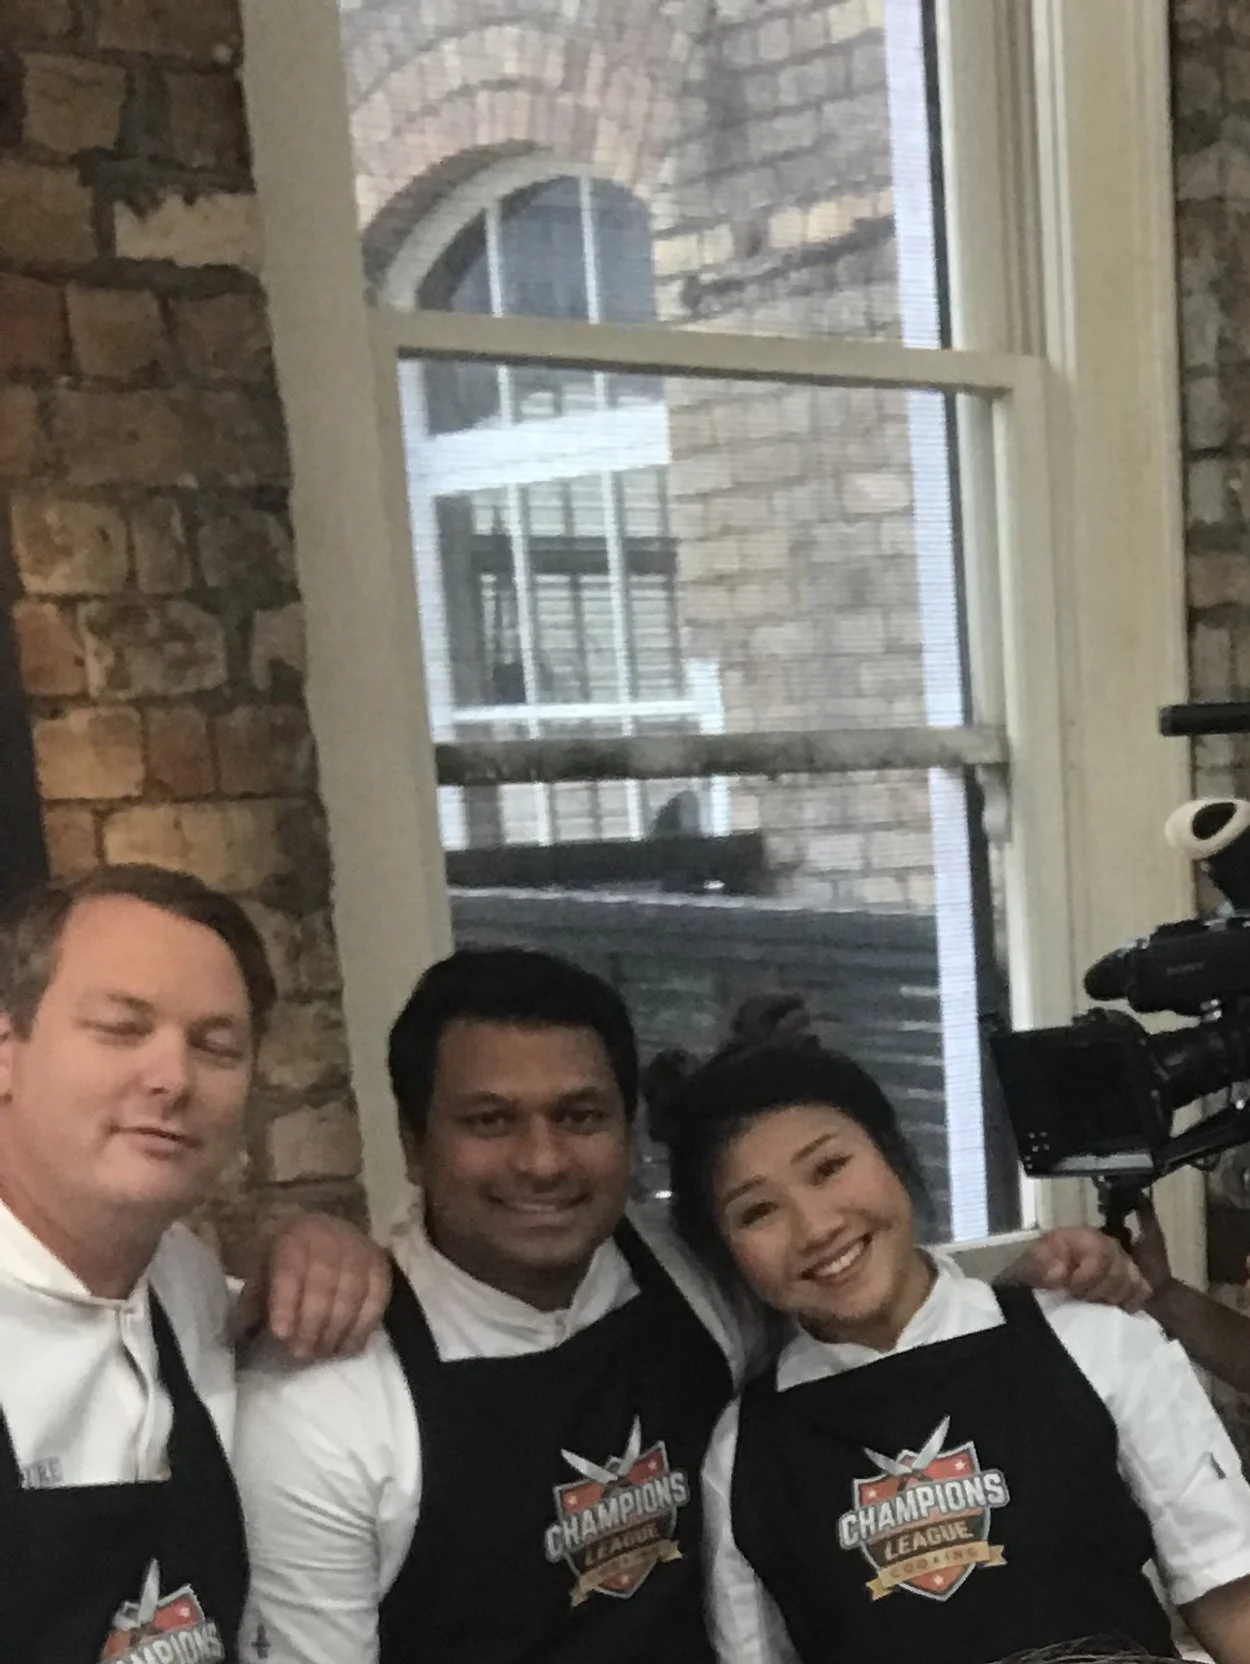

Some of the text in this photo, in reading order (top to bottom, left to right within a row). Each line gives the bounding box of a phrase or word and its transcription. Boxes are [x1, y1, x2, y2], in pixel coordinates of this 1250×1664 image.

[546, 1472, 687, 1556] CHAMPIONS
[841, 1472, 1006, 1547] CHAMPIONS
[885, 1521, 974, 1561] LEAGUE
